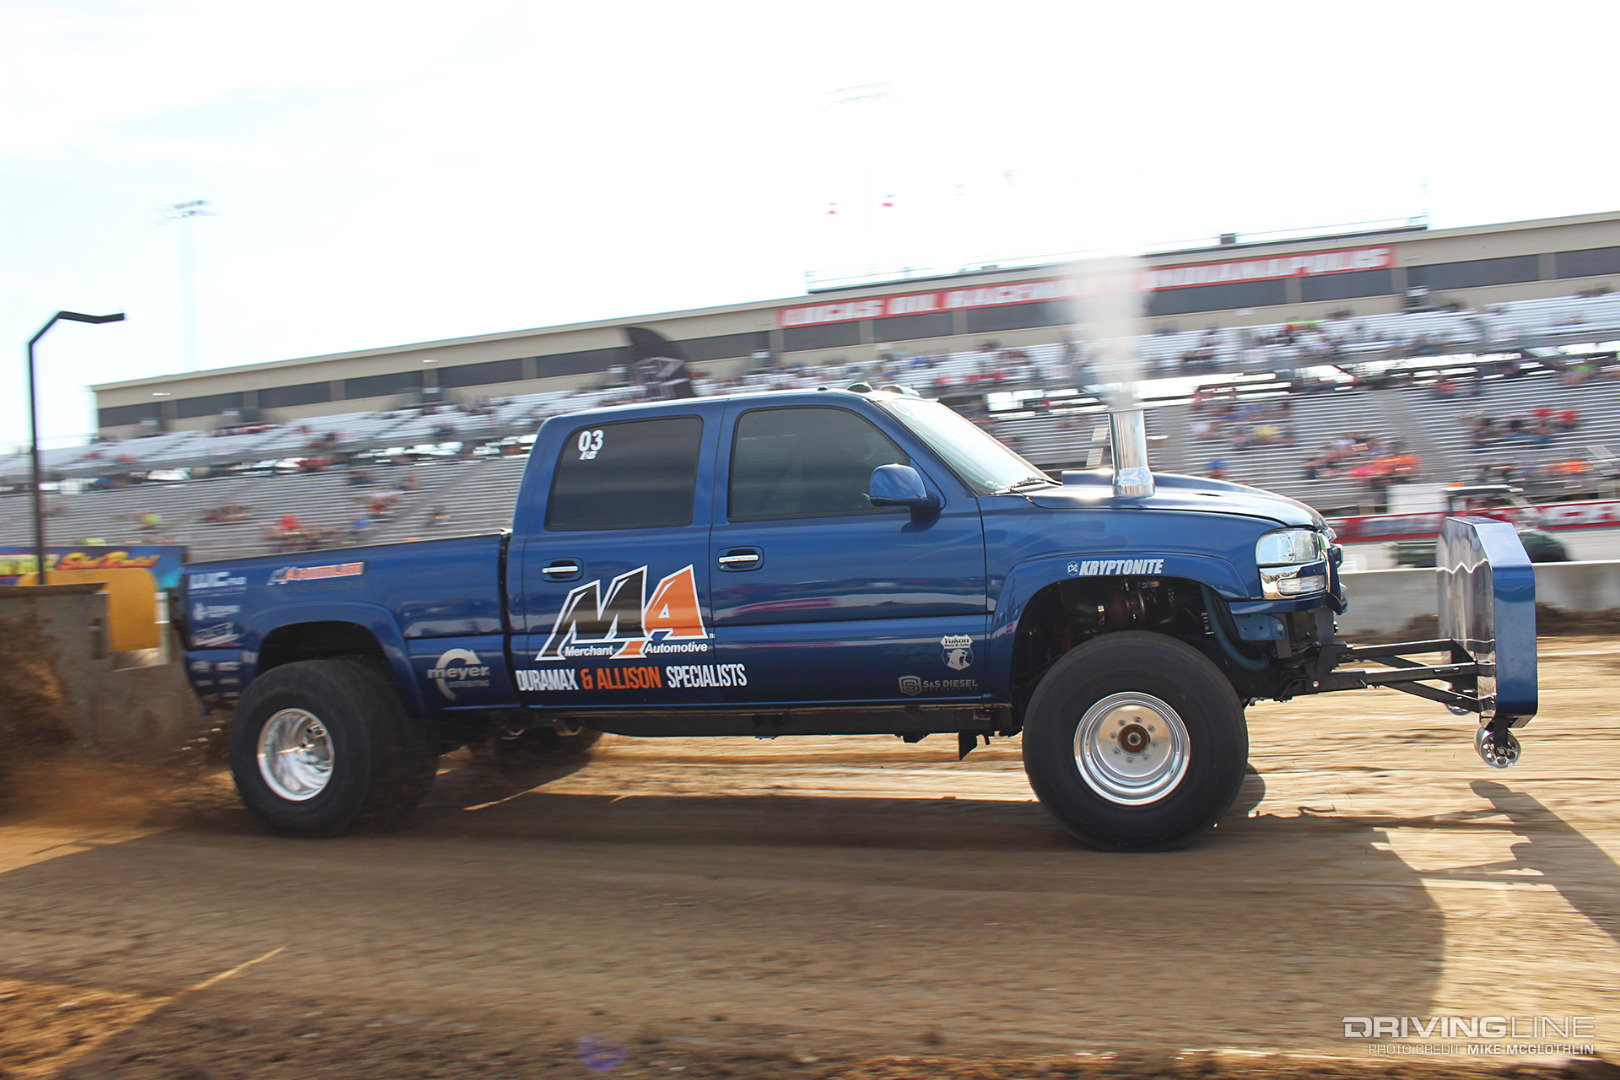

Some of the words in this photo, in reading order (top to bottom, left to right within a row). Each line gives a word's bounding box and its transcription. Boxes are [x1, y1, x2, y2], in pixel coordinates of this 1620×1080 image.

[578, 429, 605, 452] 03
[1078, 558, 1165, 576] KRYPTONITE
[564, 645, 614, 658] Merchant
[645, 642, 709, 654] Automotive
[427, 666, 488, 680] meyer
[515, 668, 580, 692] DURAMAX
[581, 671, 594, 690] &
[597, 666, 662, 689] ALLISON
[667, 663, 748, 688] SPECIALISTS
[943, 679, 978, 688] DIESEL
